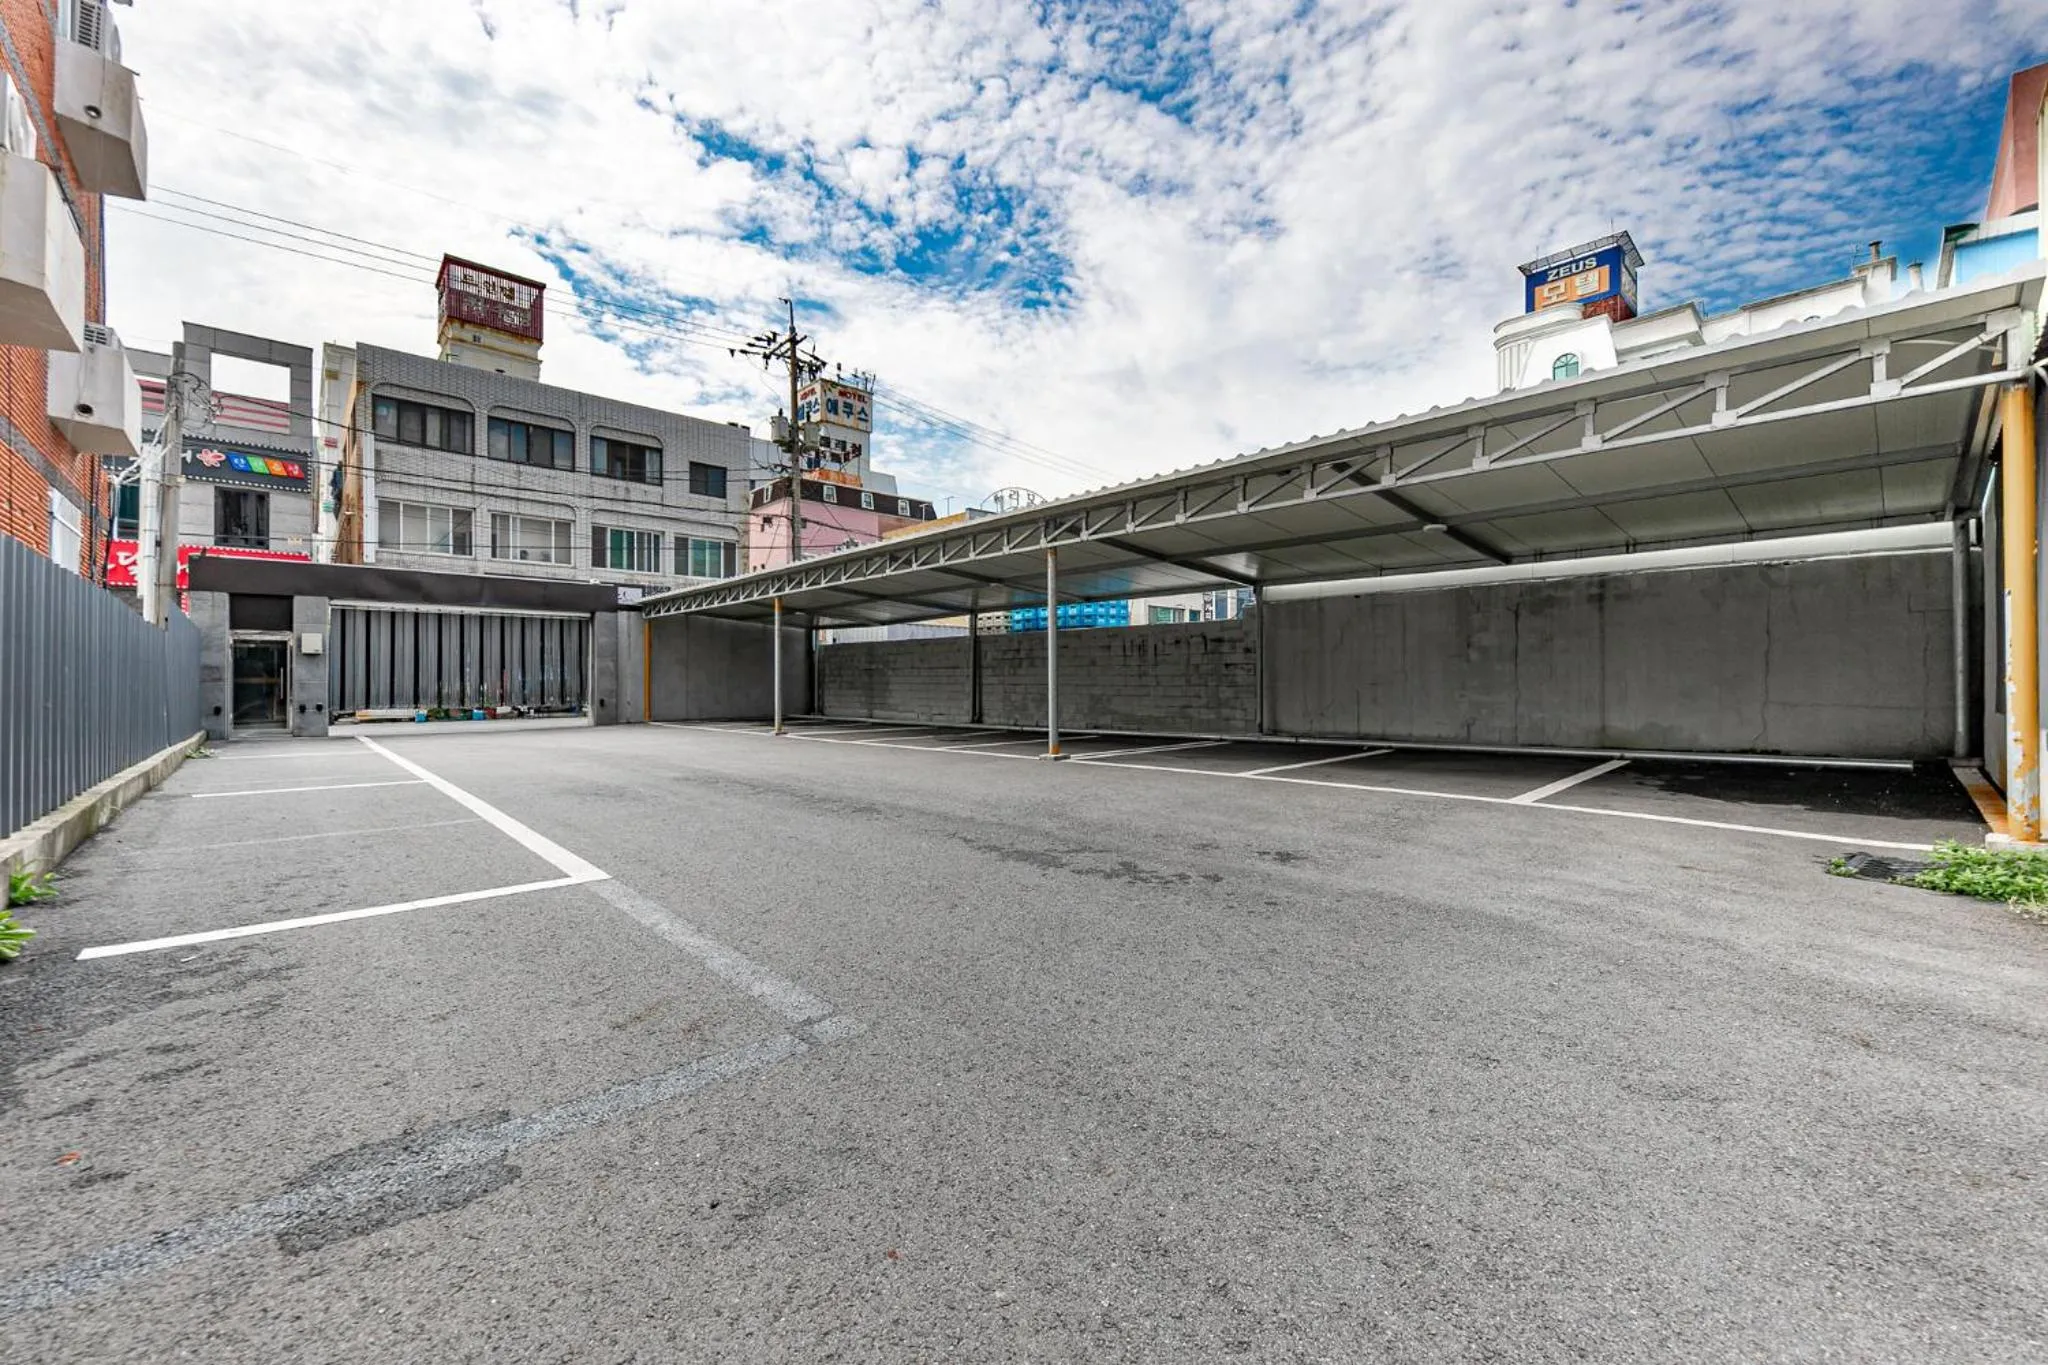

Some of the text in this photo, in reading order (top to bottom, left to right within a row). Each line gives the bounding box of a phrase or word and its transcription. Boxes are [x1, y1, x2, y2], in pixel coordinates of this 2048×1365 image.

[1547, 257, 1596, 281] ZEUS
[838, 390, 867, 403] MOTEL
[827, 398, 869, 422] 에쿠스
